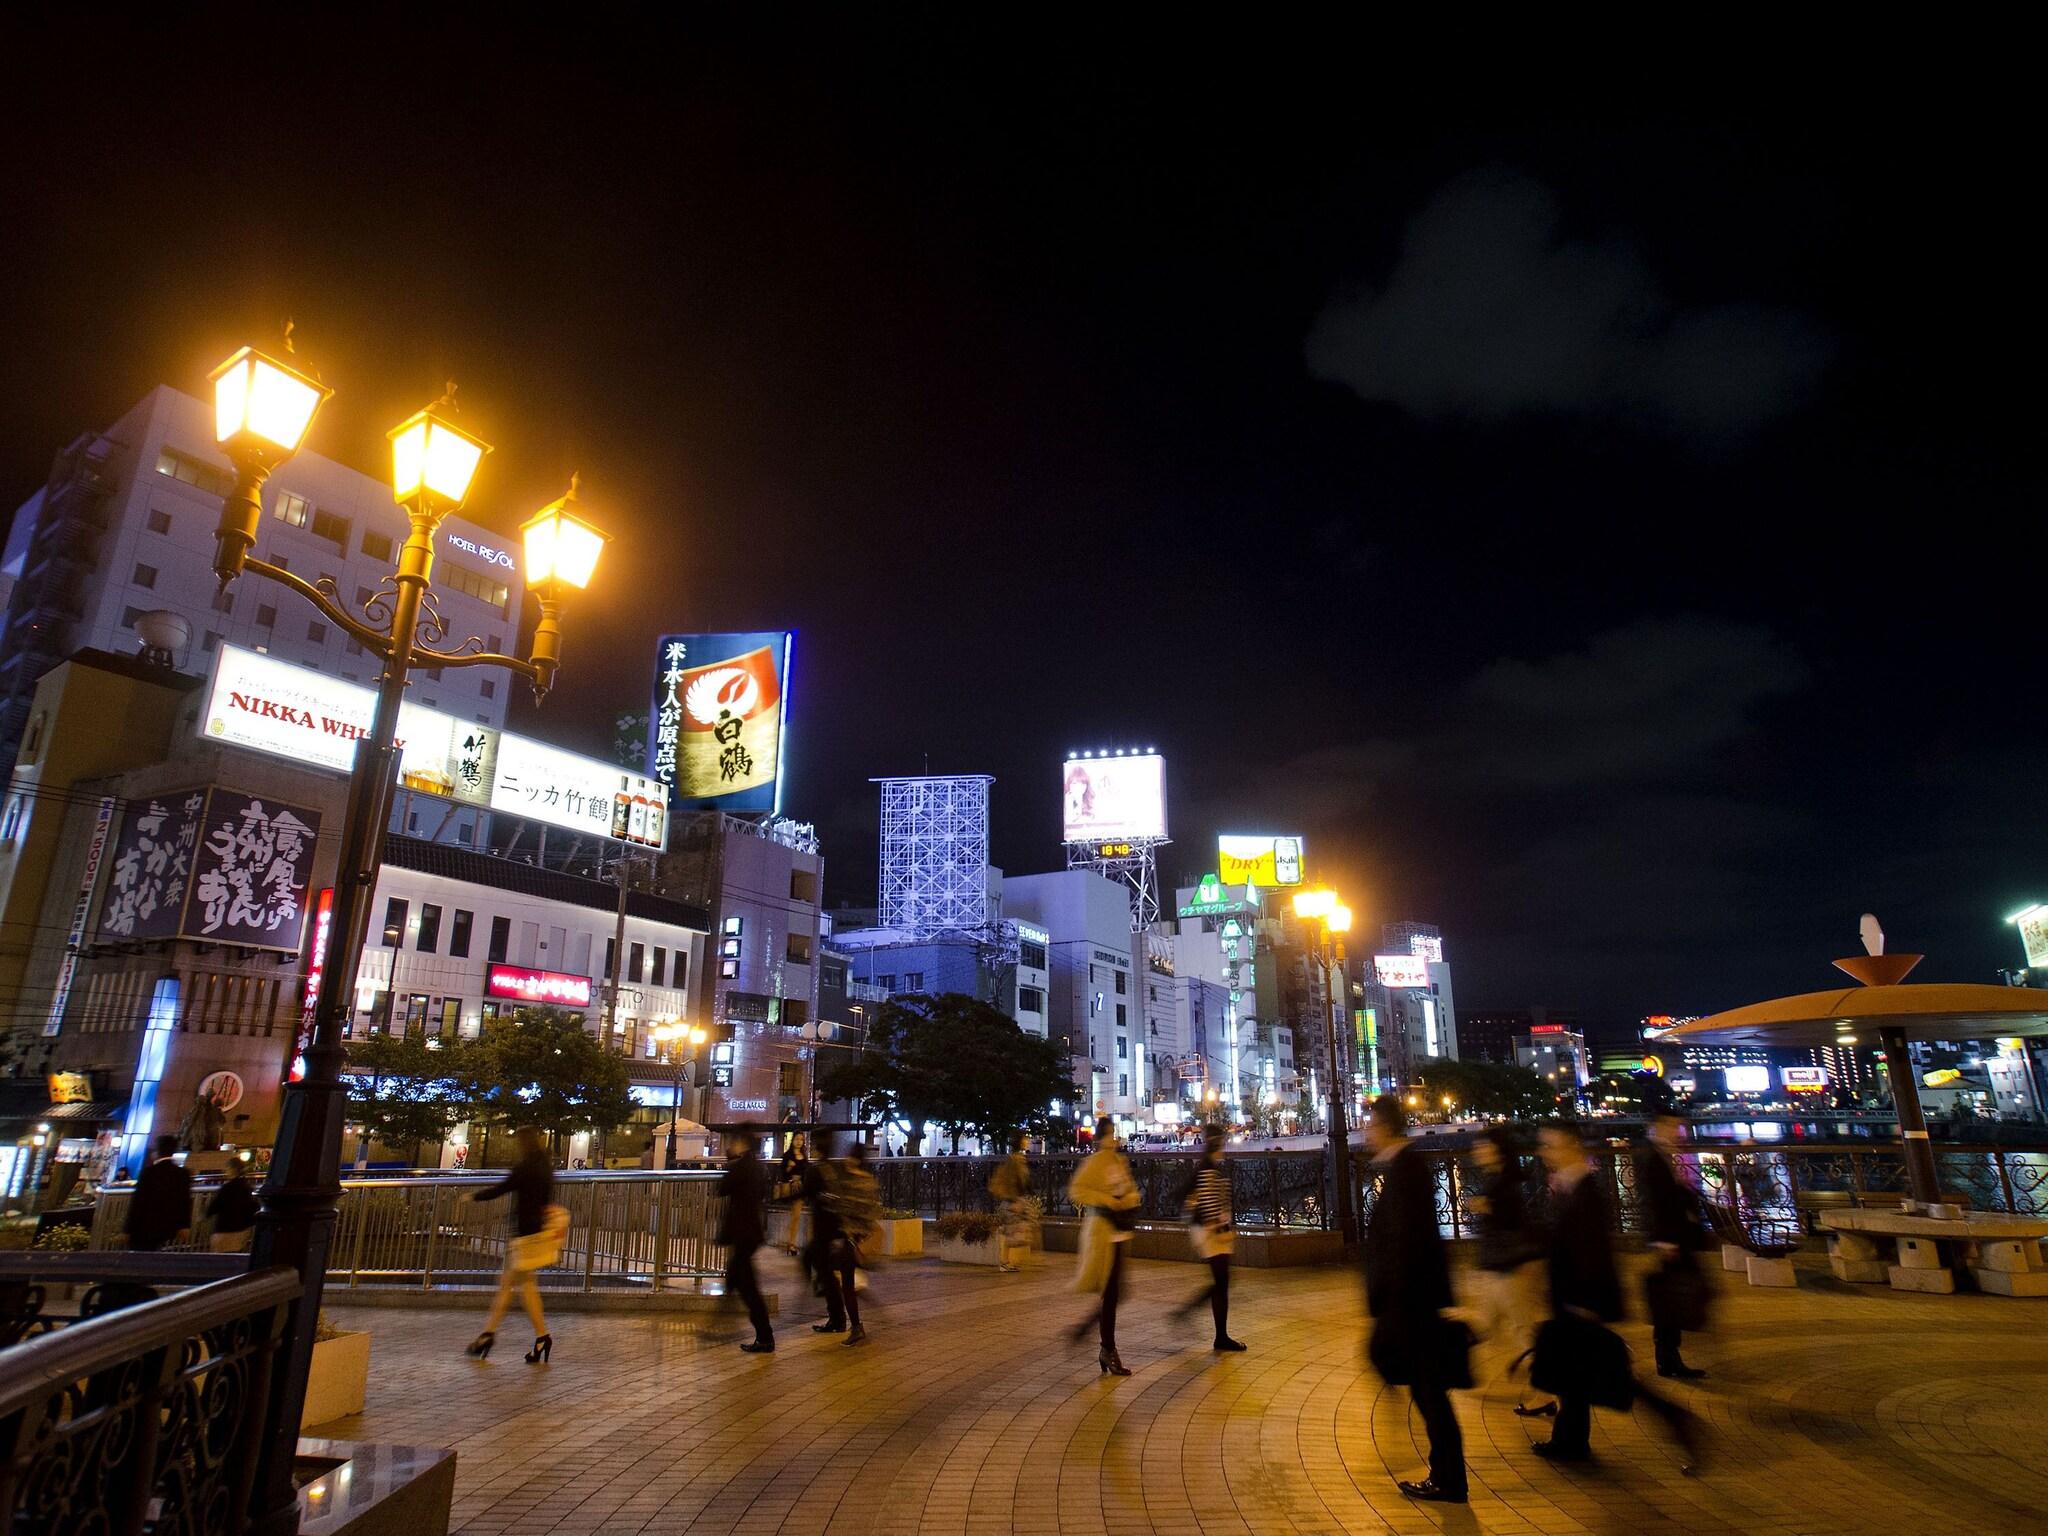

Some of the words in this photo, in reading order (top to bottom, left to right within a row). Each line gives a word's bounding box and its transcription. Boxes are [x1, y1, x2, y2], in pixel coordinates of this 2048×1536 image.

[448, 534, 478, 554] HOTEL
[479, 545, 515, 570] RESOL
[228, 691, 316, 729] NIKKA
[459, 734, 486, 787] 竹鶴
[714, 708, 753, 782] 白鶴
[500, 775, 608, 822] ニッカ竹鶴
[1180, 902, 1242, 916] ウチヤマグループ
